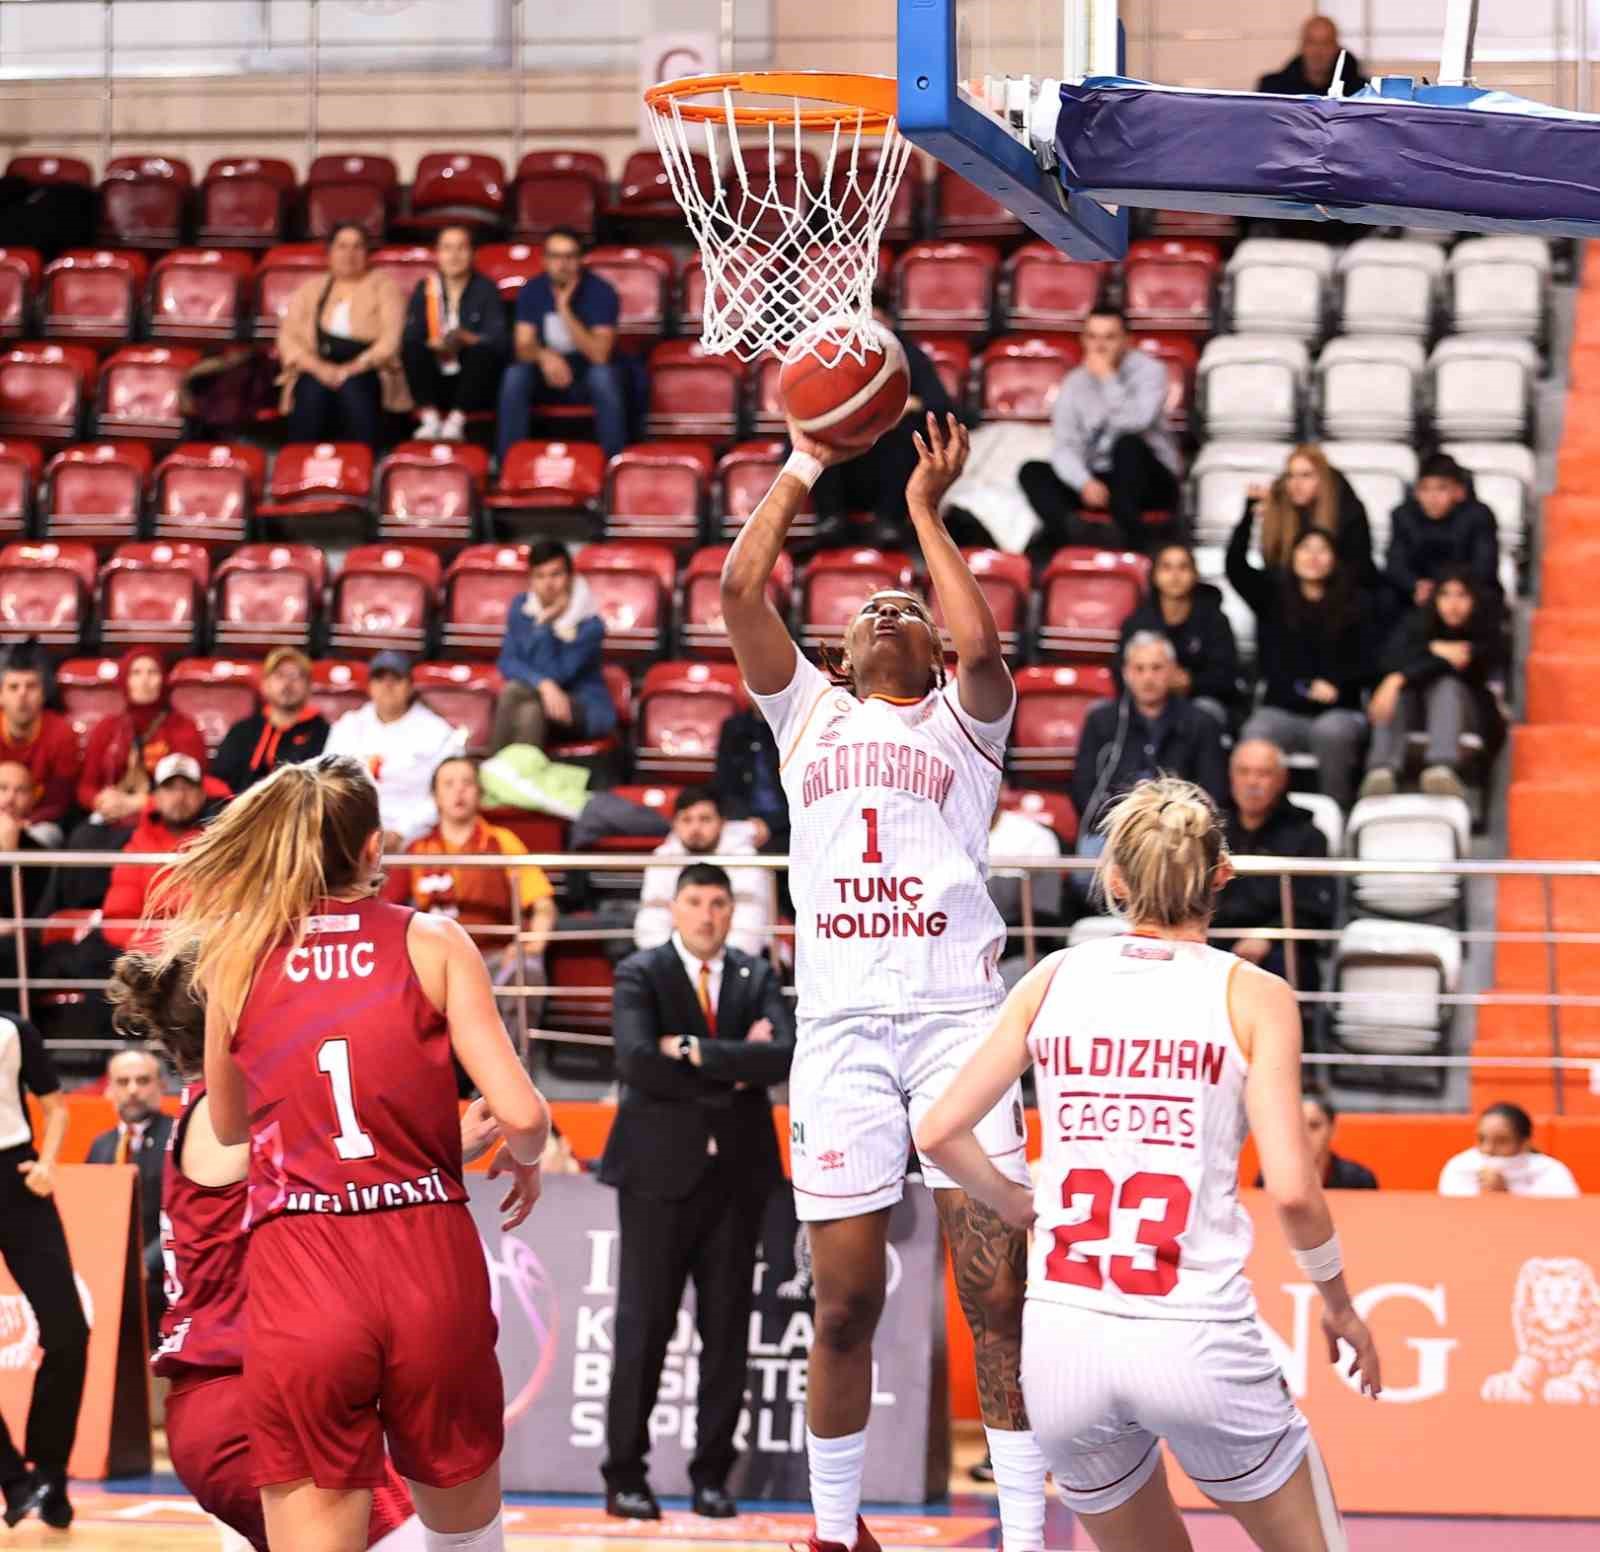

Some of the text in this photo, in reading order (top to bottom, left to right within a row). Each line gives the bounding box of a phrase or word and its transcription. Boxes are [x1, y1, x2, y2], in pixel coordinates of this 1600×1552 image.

[803, 742, 955, 812] GALATASARAY
[862, 808, 882, 863] 1
[834, 876, 924, 911] TUNÇ
[816, 905, 948, 939] HOLDİNG
[286, 941, 376, 983] CUIC
[1035, 1036, 1227, 1086] YILDIZHAN
[316, 1037, 377, 1162] 1
[1045, 1168, 1193, 1297] 23
[1255, 1283, 1459, 1403] NG
